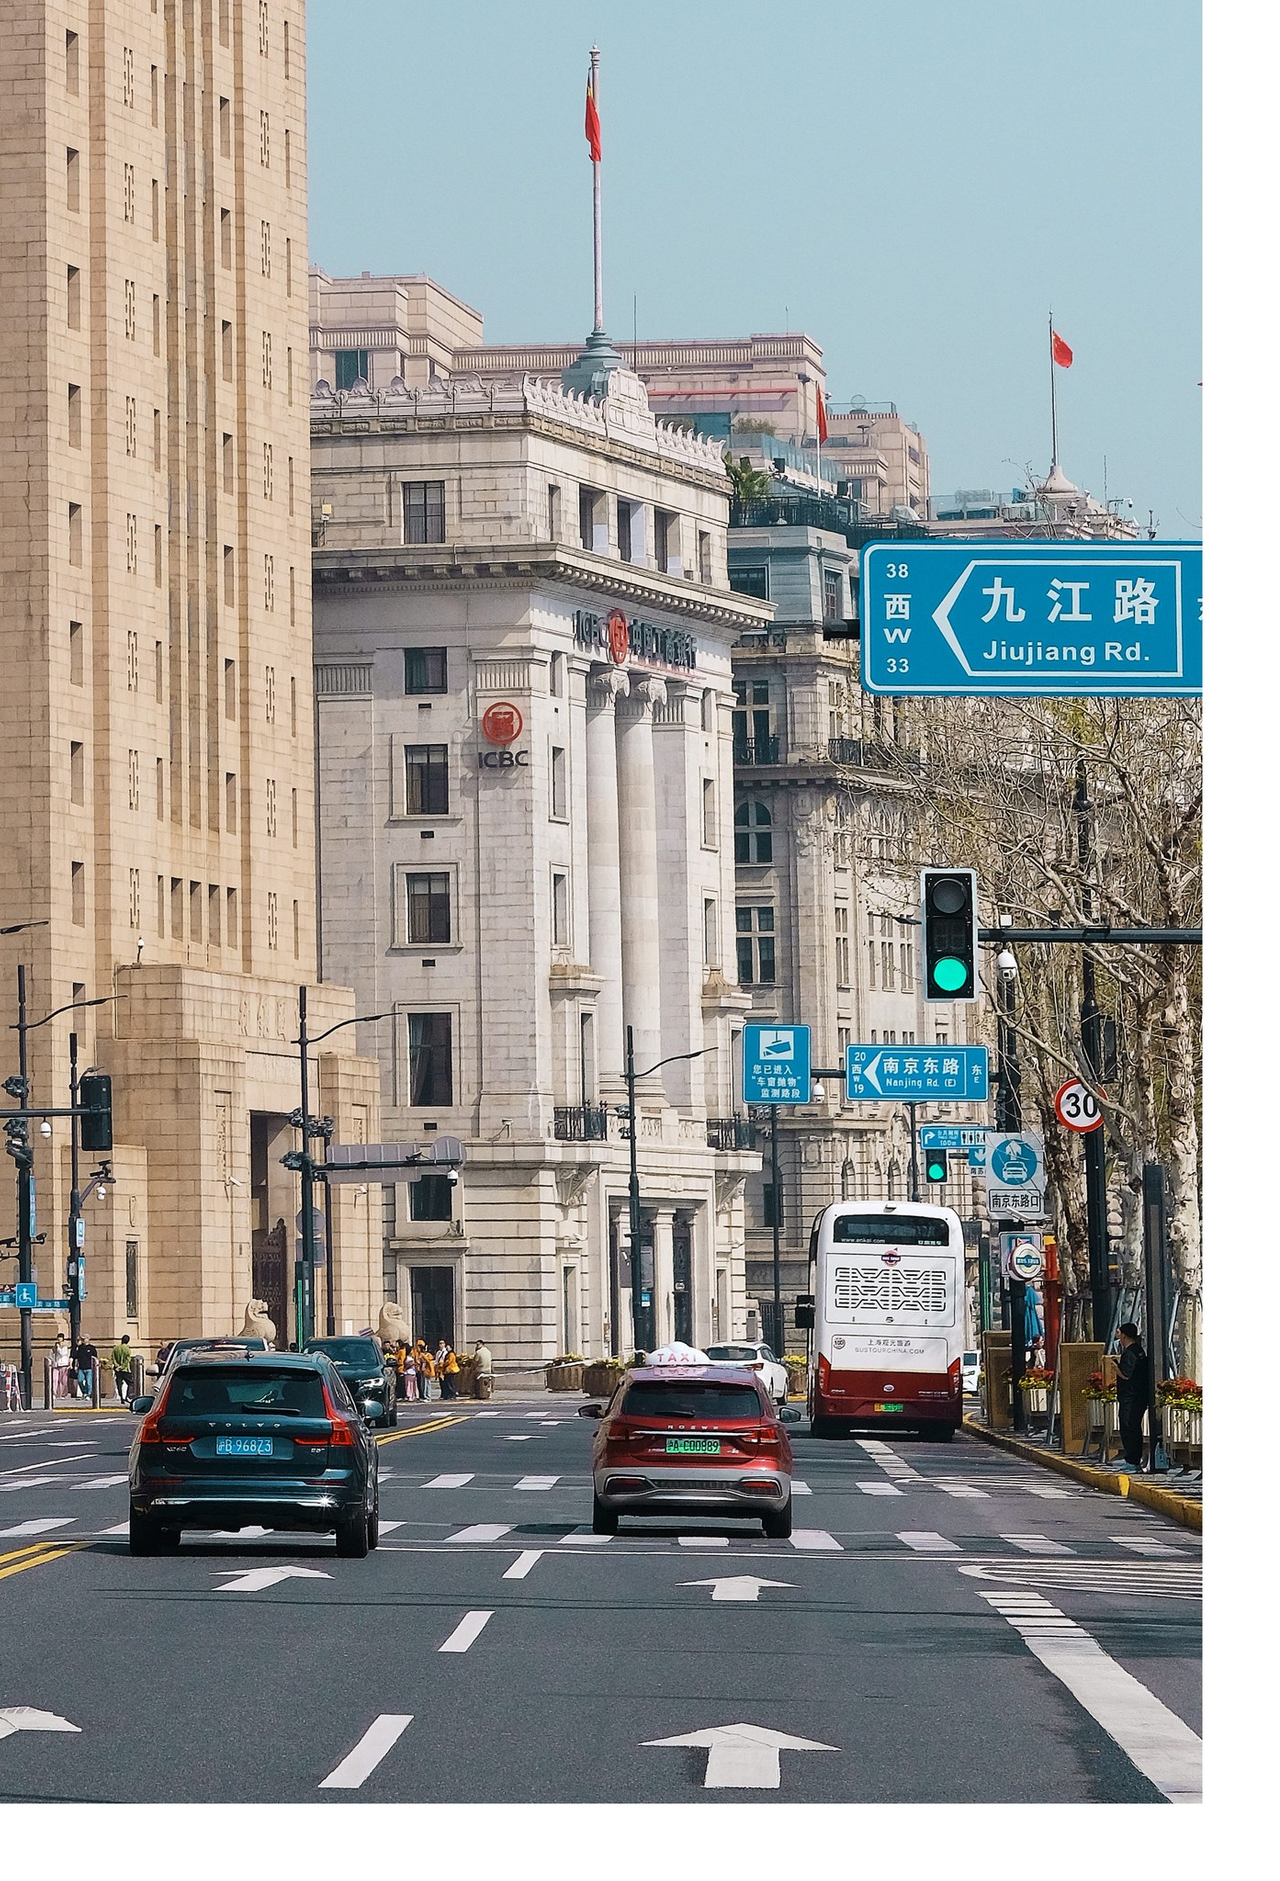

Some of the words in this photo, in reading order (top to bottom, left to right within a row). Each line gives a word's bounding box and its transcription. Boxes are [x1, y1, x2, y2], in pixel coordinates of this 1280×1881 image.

[886, 563, 909, 579] 38
[884, 594, 912, 620] 西
[980, 576, 1160, 625] 九江路
[884, 628, 912, 644] W
[983, 641, 1096, 666] Jiujiang
[1105, 641, 1150, 662] Rd.
[886, 658, 910, 673] 33
[478, 750, 529, 769] ICBC
[854, 1052, 866, 1061] 20
[753, 1064, 792, 1075] 您已进入
[851, 1064, 862, 1075] 西
[883, 1057, 959, 1075] 南京东路
[971, 1064, 982, 1076] 东
[854, 1084, 864, 1094] 19
[886, 1078, 922, 1089] Nanjing
[945, 1079, 956, 1087] (E)
[1066, 1093, 1098, 1118] 30
[992, 1194, 1039, 1207] 南京东路口
[657, 1353, 697, 1362] TAXI
